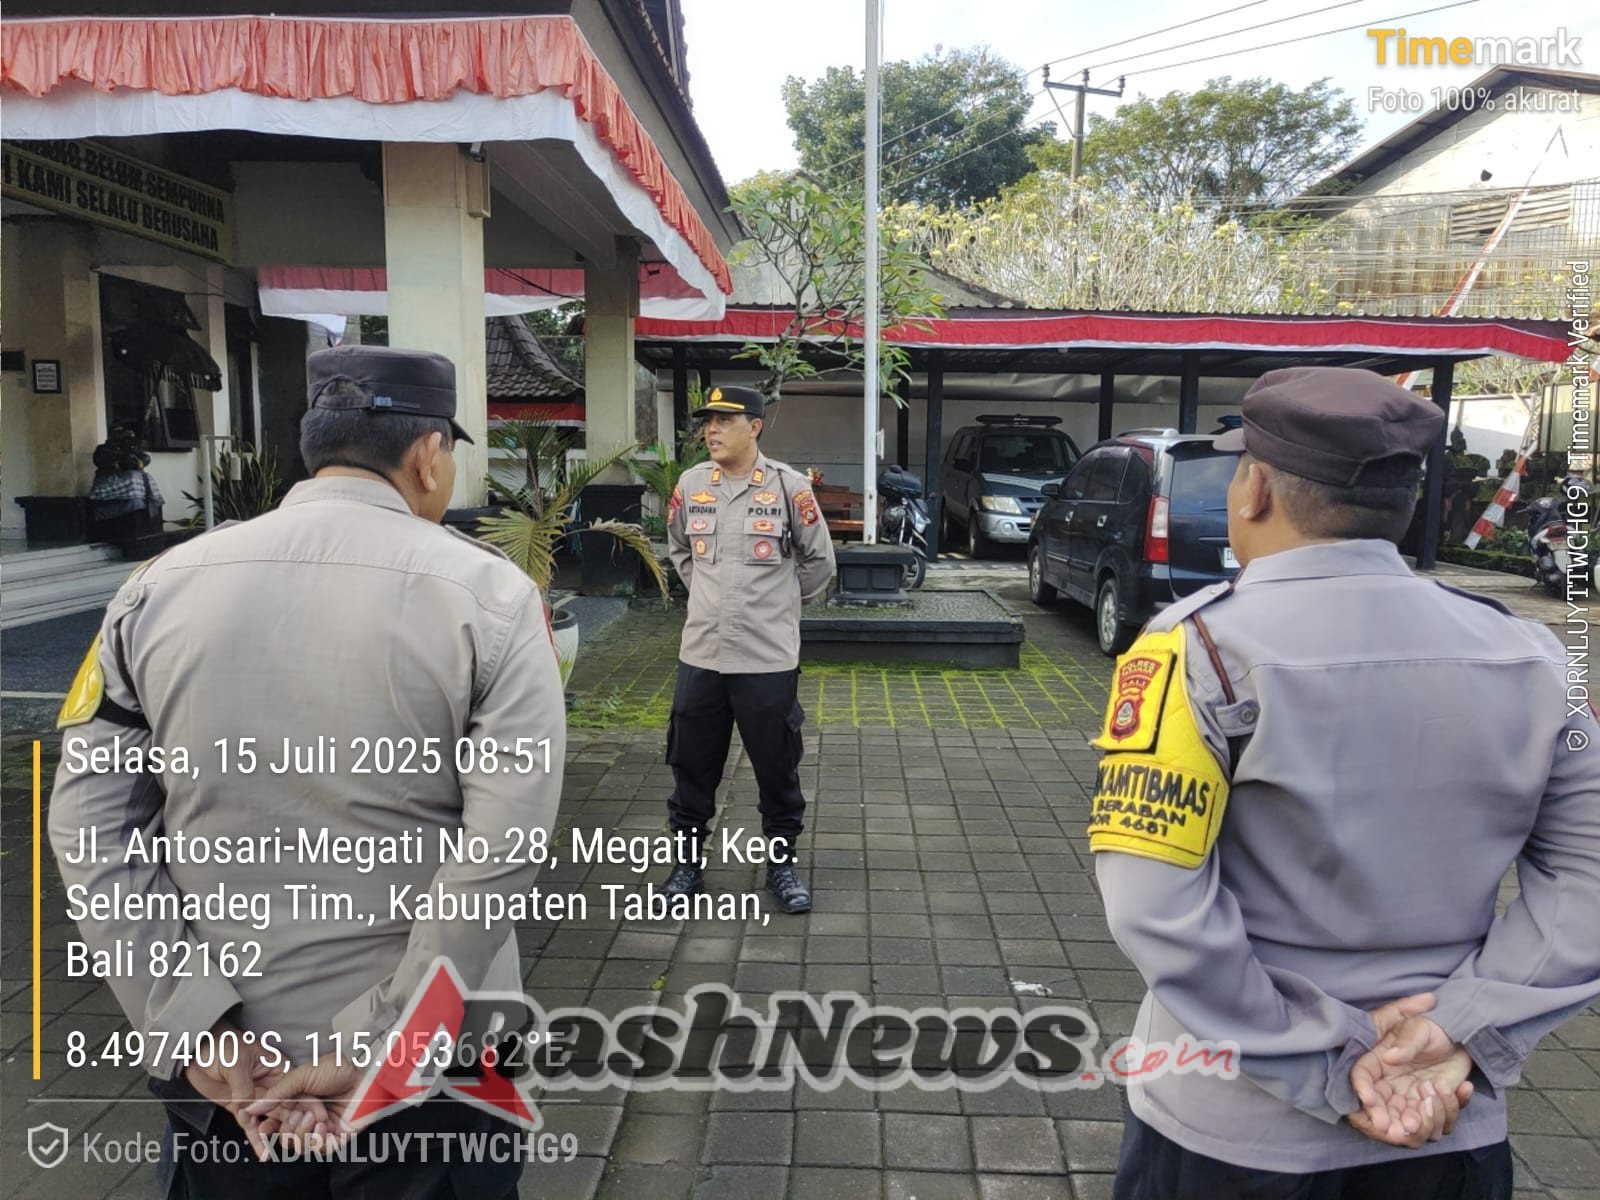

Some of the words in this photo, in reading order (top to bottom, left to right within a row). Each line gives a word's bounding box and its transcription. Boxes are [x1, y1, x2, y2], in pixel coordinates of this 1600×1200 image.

[17, 157, 72, 205] KAMI
[76, 179, 139, 225] SELALU
[142, 203, 219, 253] BERUSAHA
[85, 147, 144, 193] BELUM
[146, 171, 225, 224] SEMPURNA
[747, 506, 782, 517] POLRI
[1119, 816, 1168, 837] 4681
